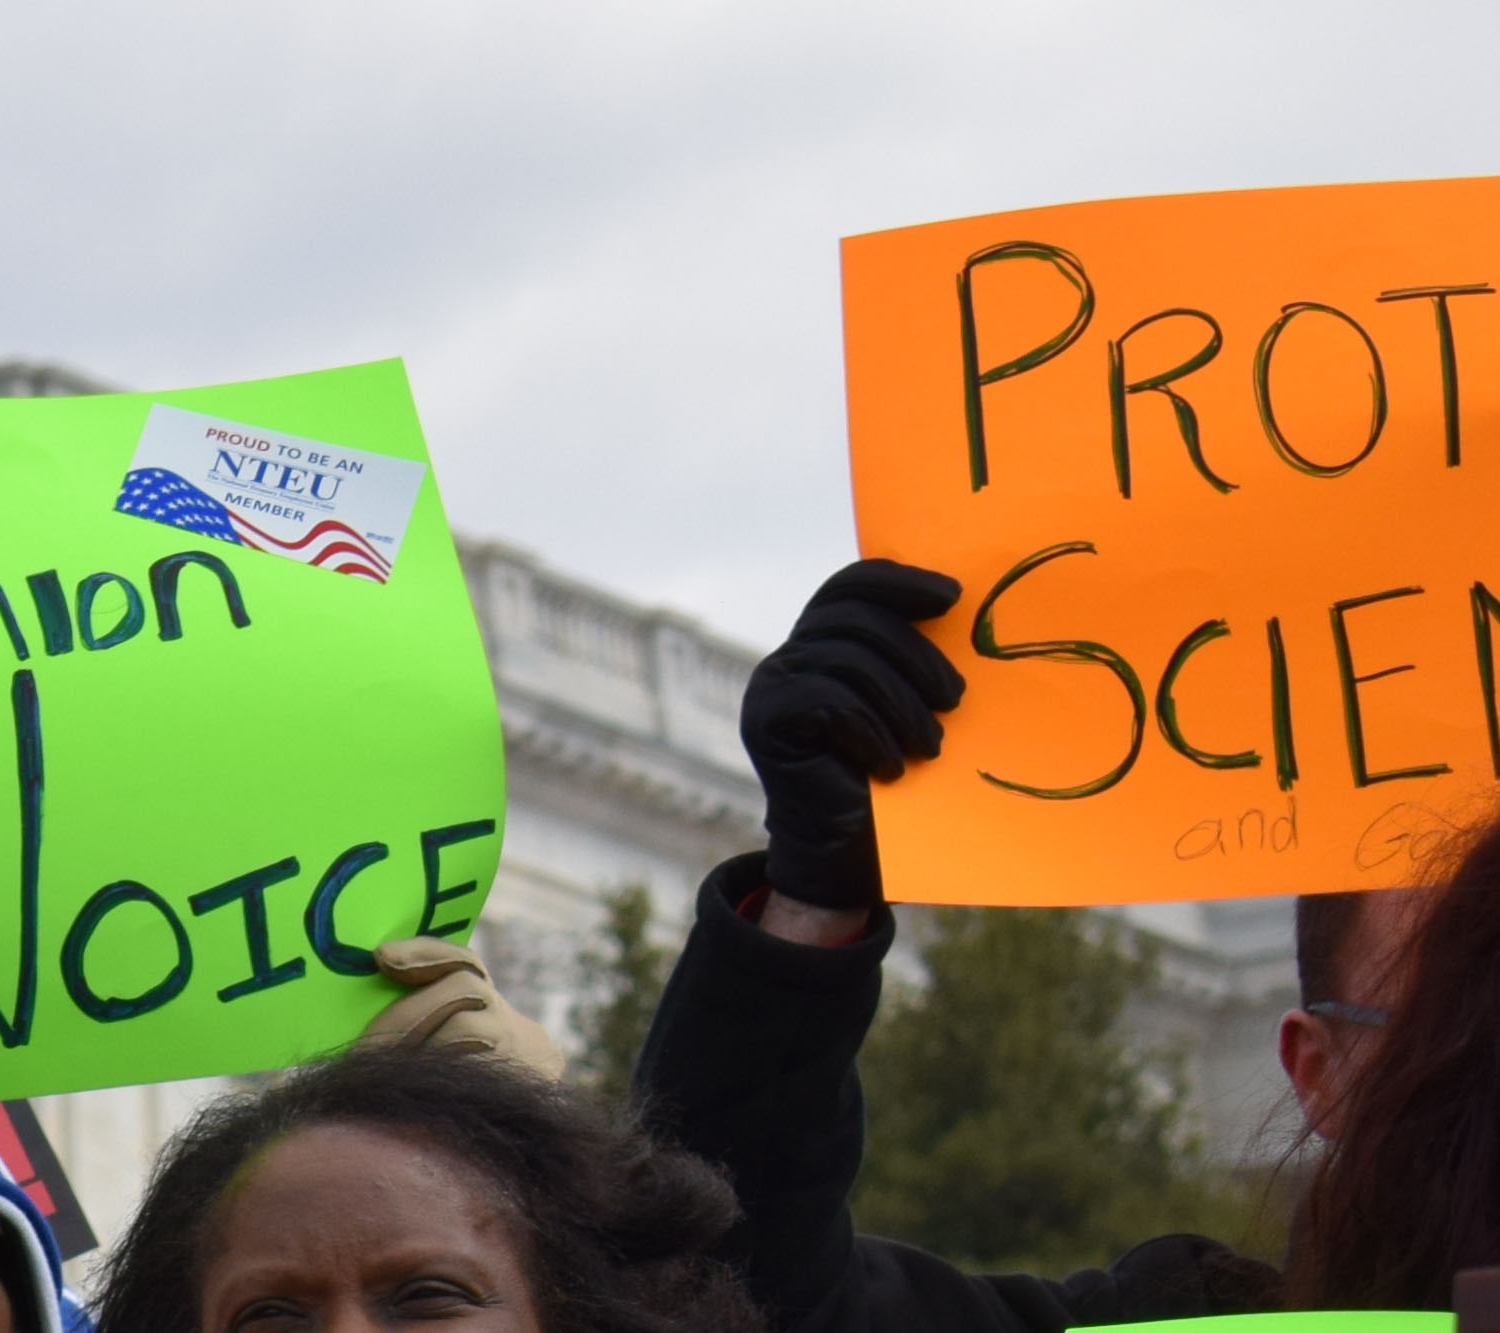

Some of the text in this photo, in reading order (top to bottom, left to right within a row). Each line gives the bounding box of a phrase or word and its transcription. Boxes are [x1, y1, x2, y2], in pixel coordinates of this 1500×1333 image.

[956, 240, 1497, 500] PROT
[205, 427, 364, 474] PROUD TO BE AN
[210, 448, 344, 502] NTEU
[224, 492, 305, 522] MEMBER
[1174, 795, 1300, 862] and
